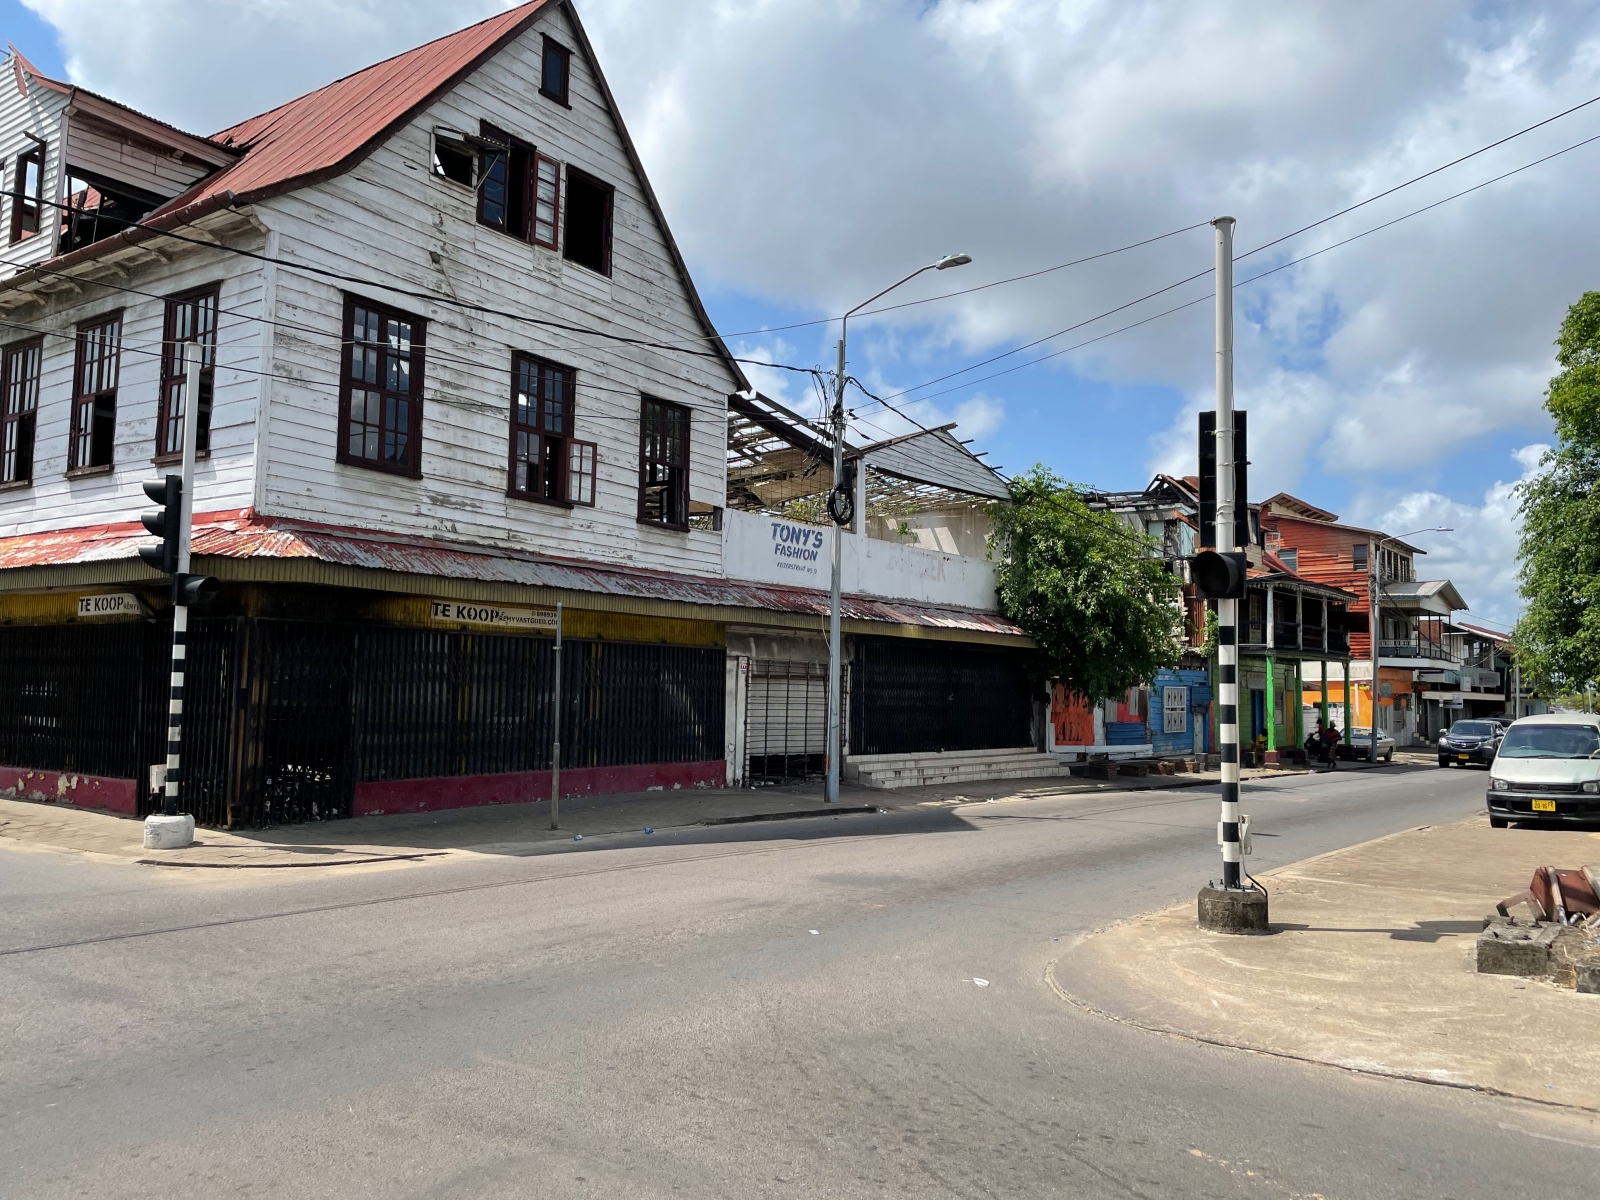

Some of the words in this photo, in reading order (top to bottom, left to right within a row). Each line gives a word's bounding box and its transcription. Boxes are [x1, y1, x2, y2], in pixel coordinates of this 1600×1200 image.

[771, 522, 823, 549] TONY'S
[774, 543, 818, 562] FASHION
[79, 598, 91, 612] TE
[94, 597, 124, 612] KOOP
[432, 602, 451, 618] TE
[456, 605, 499, 622] KOOP
